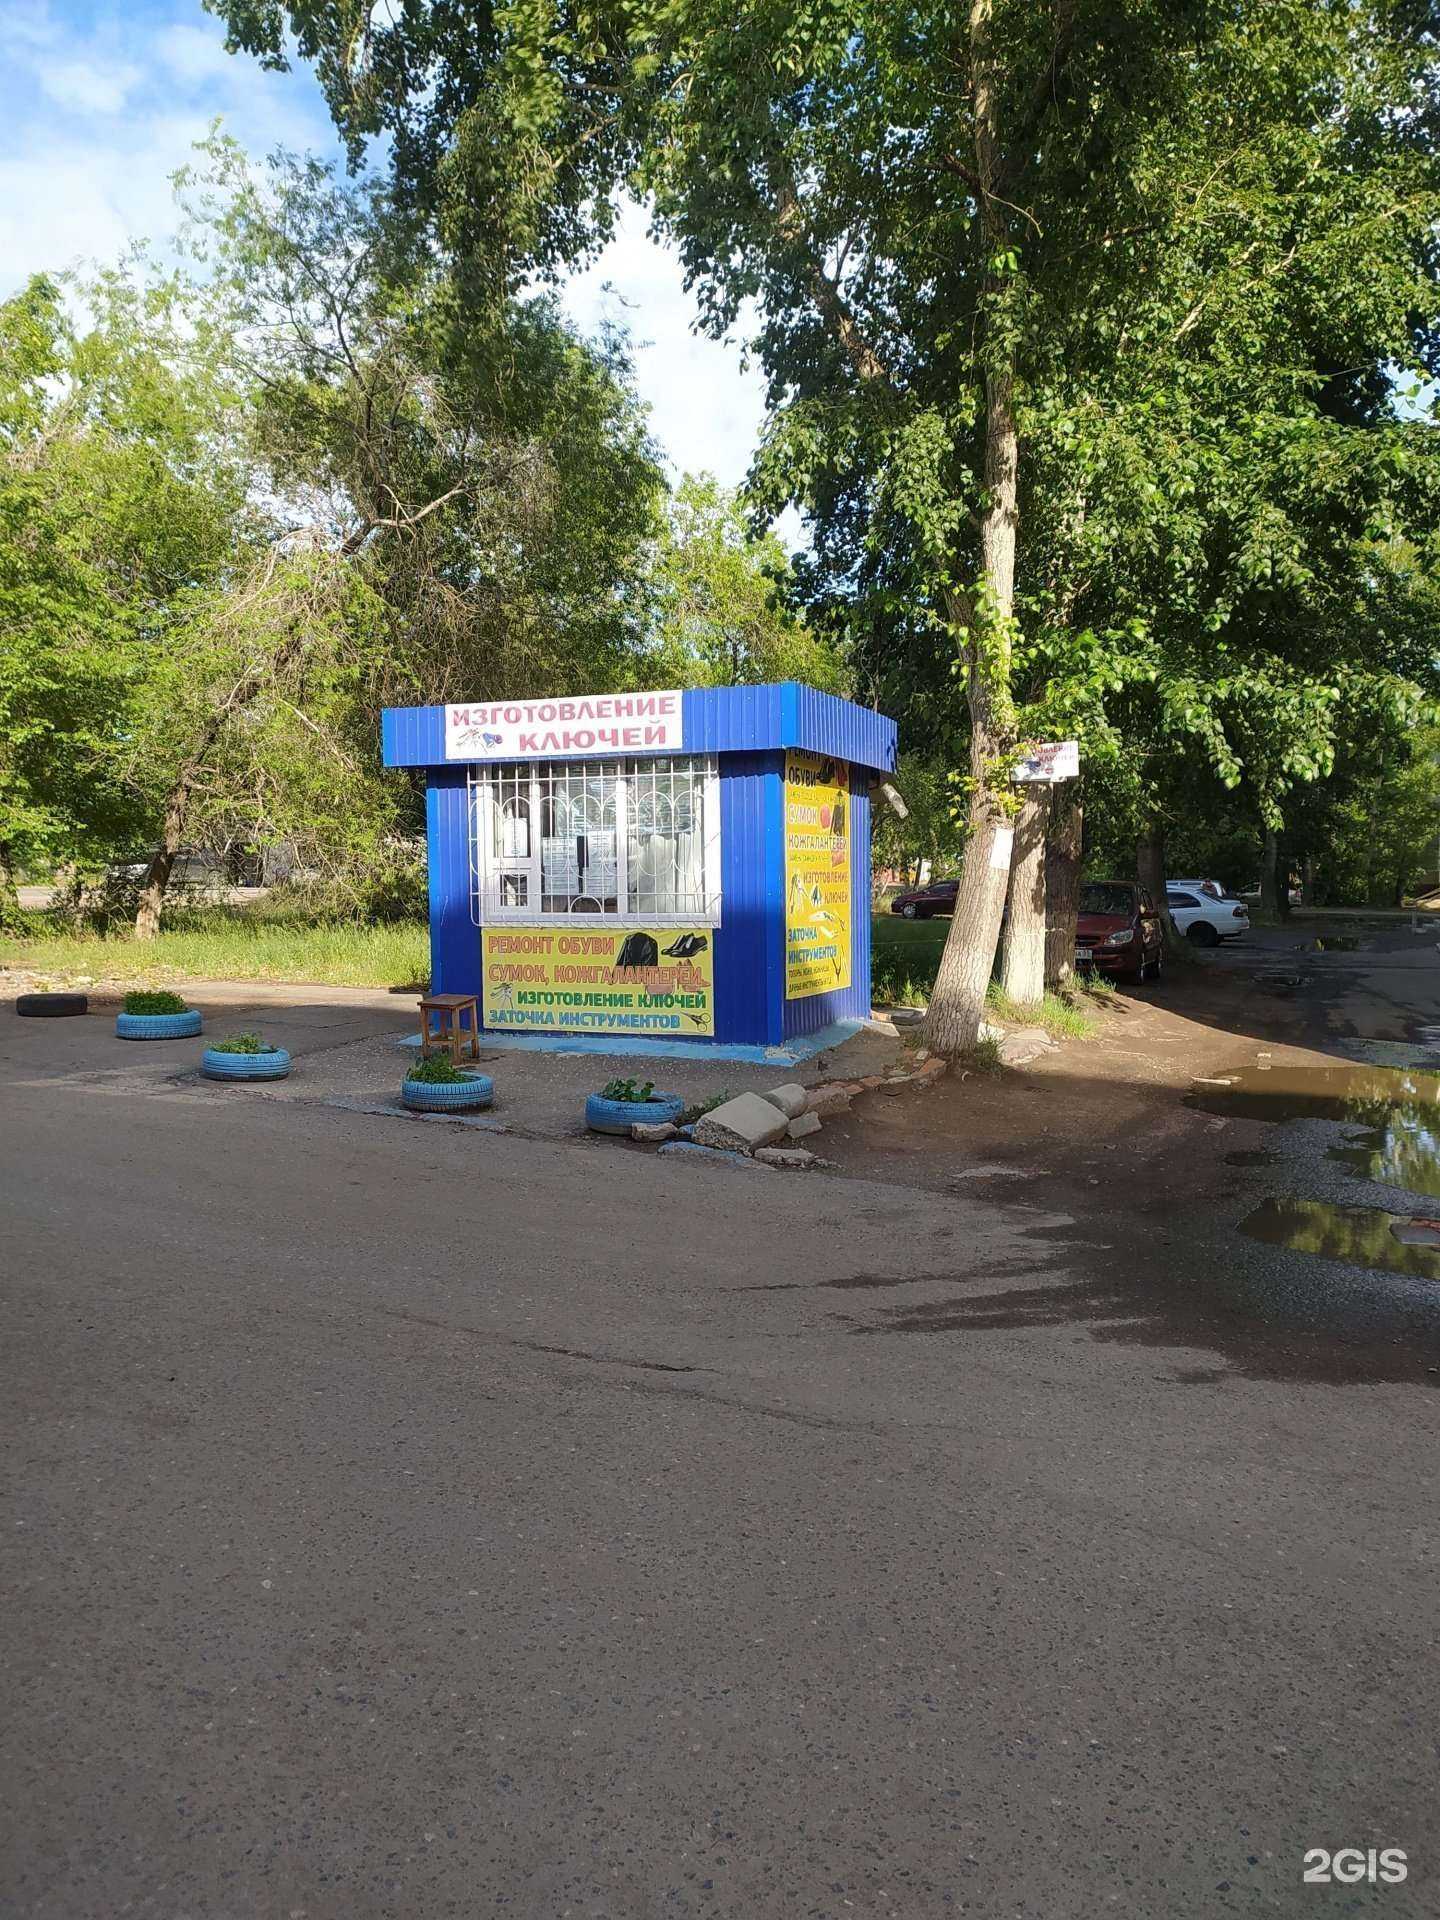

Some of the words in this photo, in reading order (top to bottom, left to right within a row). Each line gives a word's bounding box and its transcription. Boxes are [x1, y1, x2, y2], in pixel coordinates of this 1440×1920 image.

[452, 696, 676, 726] ИЗГОТОВЛЕНИЕ
[518, 720, 667, 752] КЛЮЧЕЙ
[788, 766, 816, 788] ОБУВИ
[788, 804, 817, 825] СУМОК
[803, 871, 849, 884] ИЗГОТОВЛЕНИЕ
[788, 926, 817, 943] ЗАТОЧКА
[488, 935, 554, 955] РЕМОНТ
[558, 936, 615, 955] ОБУВИ
[788, 945, 838, 965] ИНСТРУМЕНТОВ
[488, 964, 550, 986] СУМОК,
[517, 991, 633, 1008] ИЗГОТОВЛЕНИЕ
[638, 991, 707, 1009] КЛЮЧЕЙ
[489, 1010, 555, 1025] ЗАТОЧКА
[558, 1012, 681, 1029] ИНСТРУМЕНТОВ
